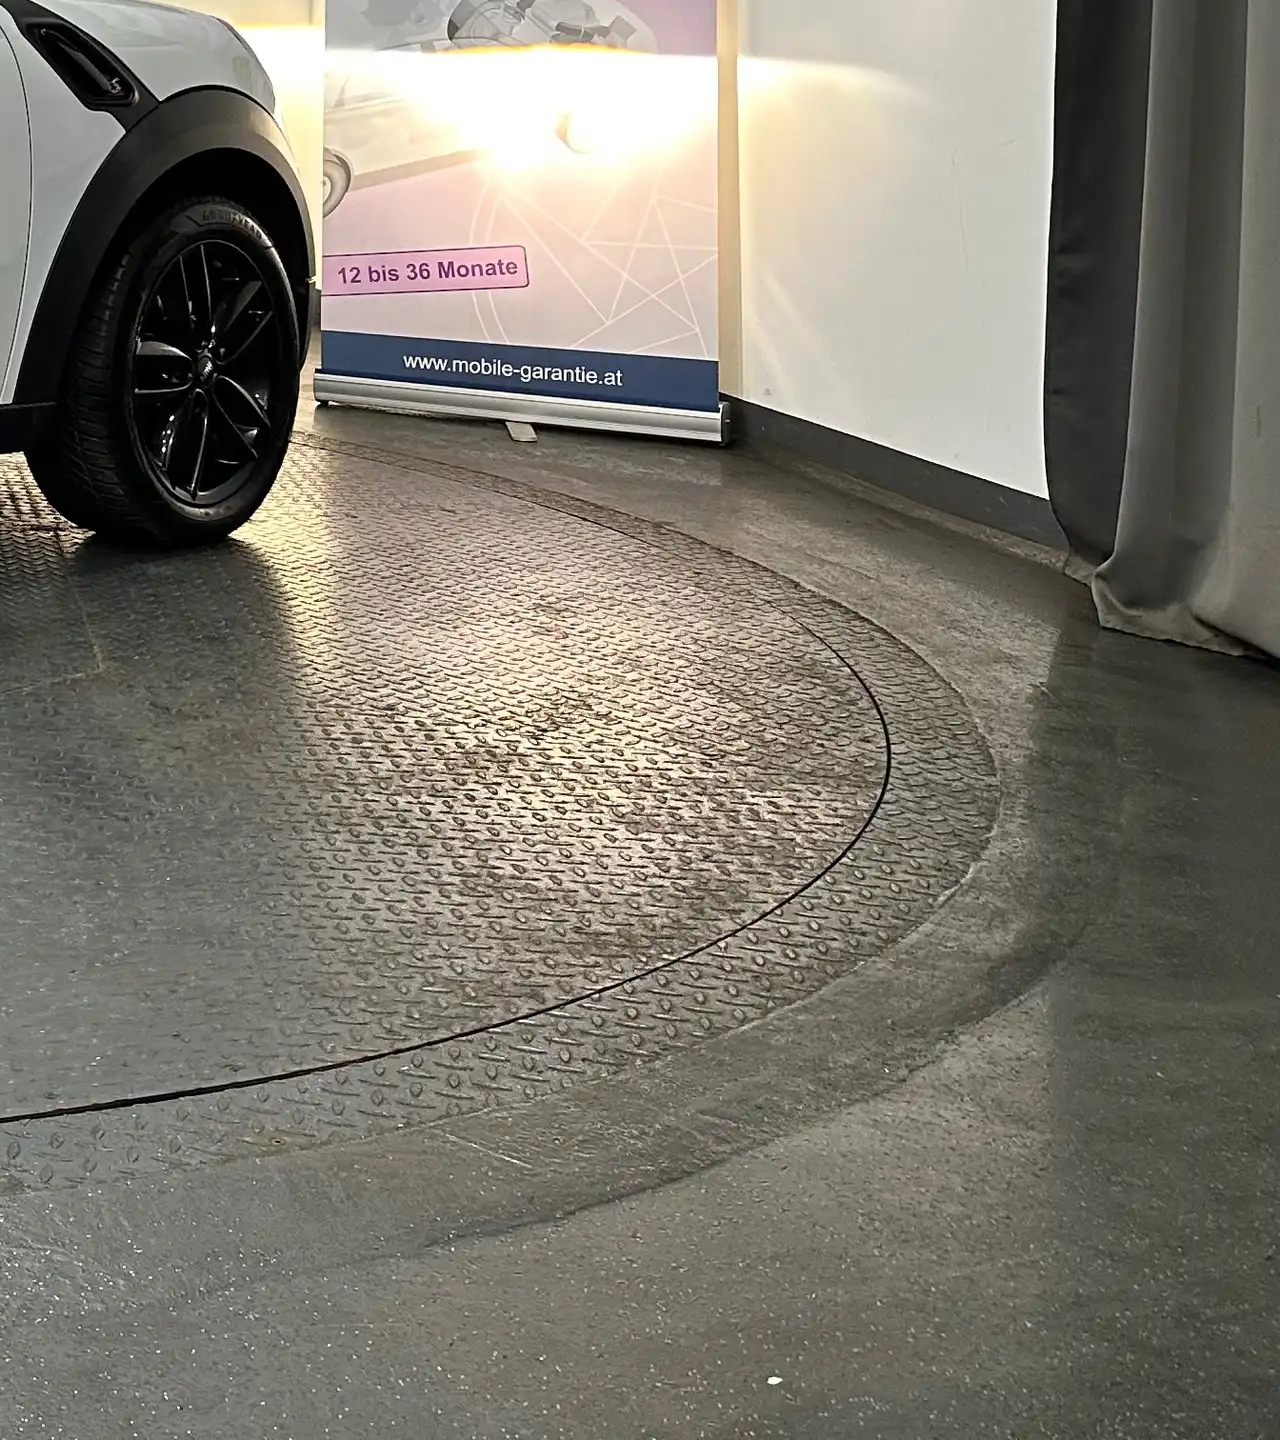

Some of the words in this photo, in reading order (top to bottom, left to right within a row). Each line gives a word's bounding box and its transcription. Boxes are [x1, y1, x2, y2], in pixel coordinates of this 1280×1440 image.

[337, 266, 362, 285] 12
[367, 264, 400, 283] bis
[406, 262, 431, 281] 36
[437, 258, 518, 279] Monate
[403, 355, 623, 387] www.mobile-garantie.at
